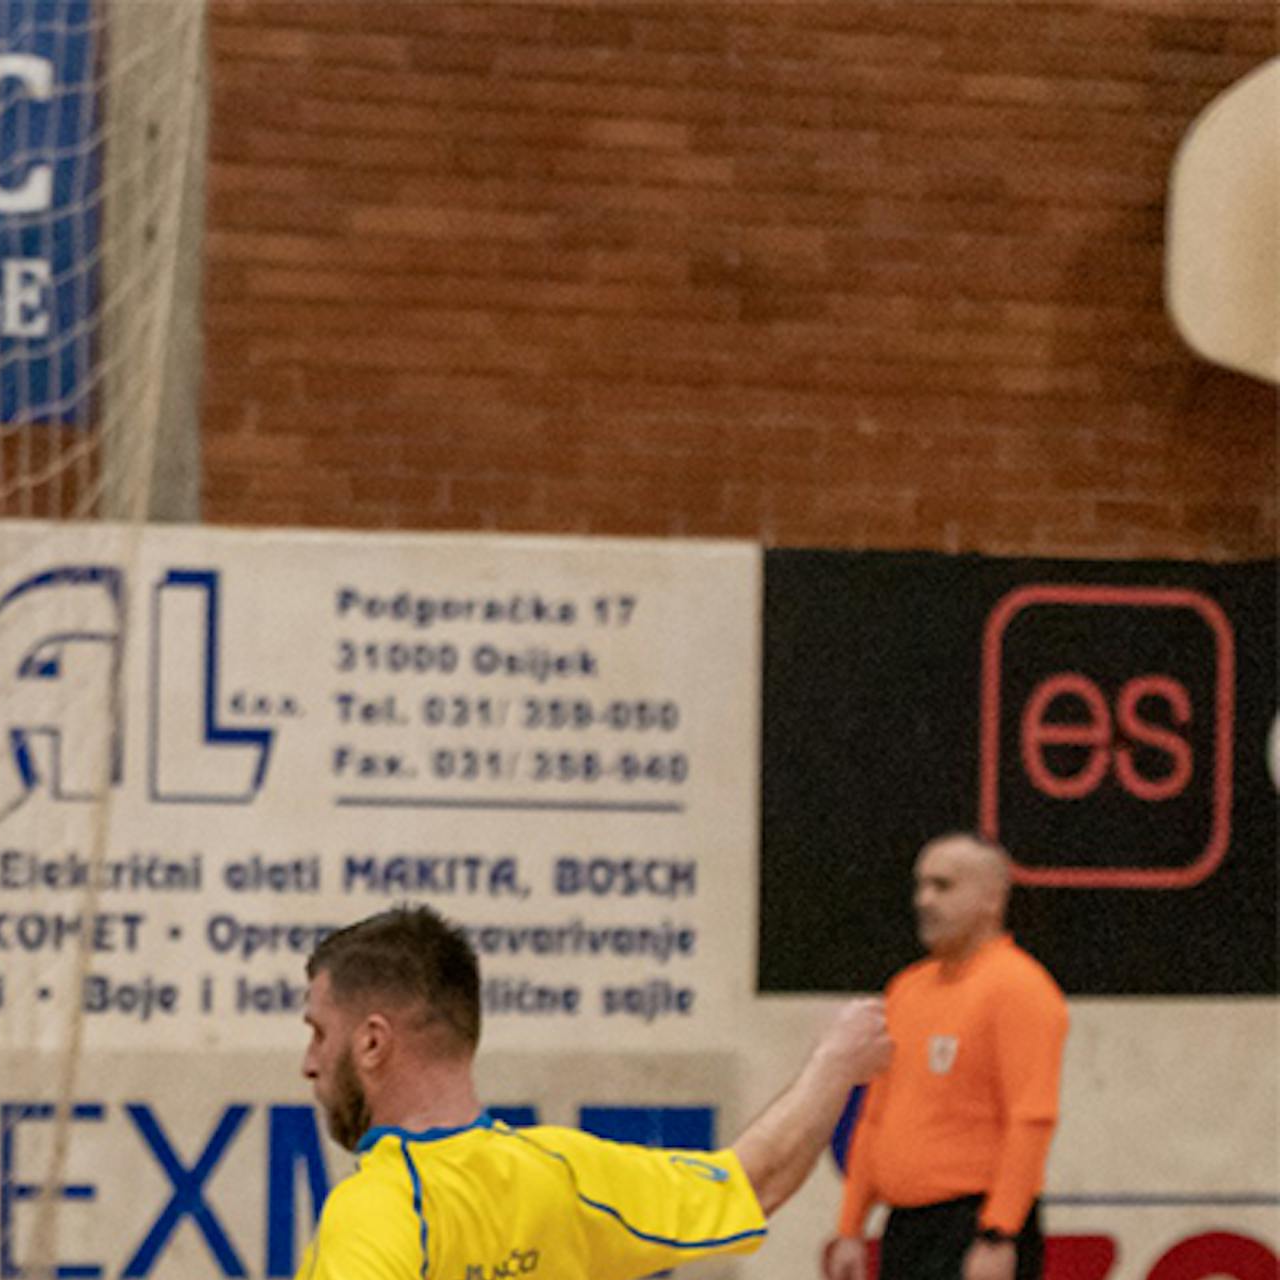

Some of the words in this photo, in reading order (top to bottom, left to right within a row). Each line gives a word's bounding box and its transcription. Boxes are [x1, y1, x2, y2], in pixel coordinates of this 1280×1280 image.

[593, 596, 637, 627] 17
[336, 640, 459, 674] 31000
[471, 642, 598, 685] Osijek
[336, 692, 410, 723] Tel.
[1020, 671, 1194, 801] es
[333, 745, 419, 778] Fax.
[555, 857, 697, 898] BOSCH
[84, 975, 178, 1022] Boje
